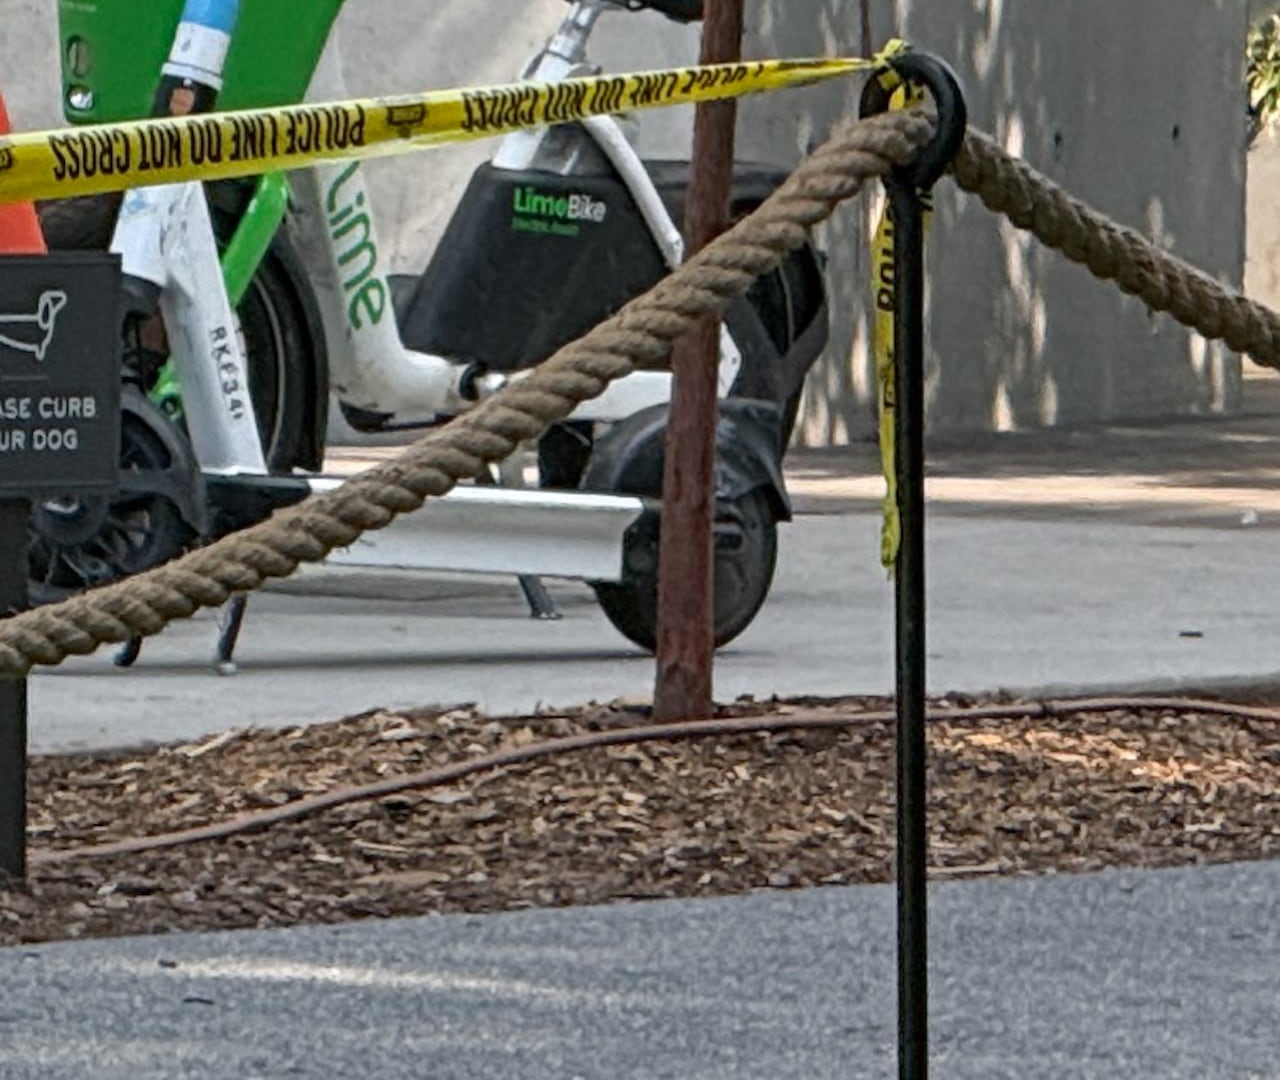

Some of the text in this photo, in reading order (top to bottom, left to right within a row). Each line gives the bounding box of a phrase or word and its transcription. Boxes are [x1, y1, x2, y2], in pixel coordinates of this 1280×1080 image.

[137, 124, 182, 172] NOT
[187, 119, 223, 166] DO
[226, 113, 279, 162] LINE
[284, 103, 366, 156] POLICE
[49, 128, 131, 182] CROSS
[37, 396, 97, 420] CURB
[33, 429, 79, 451] DOG
